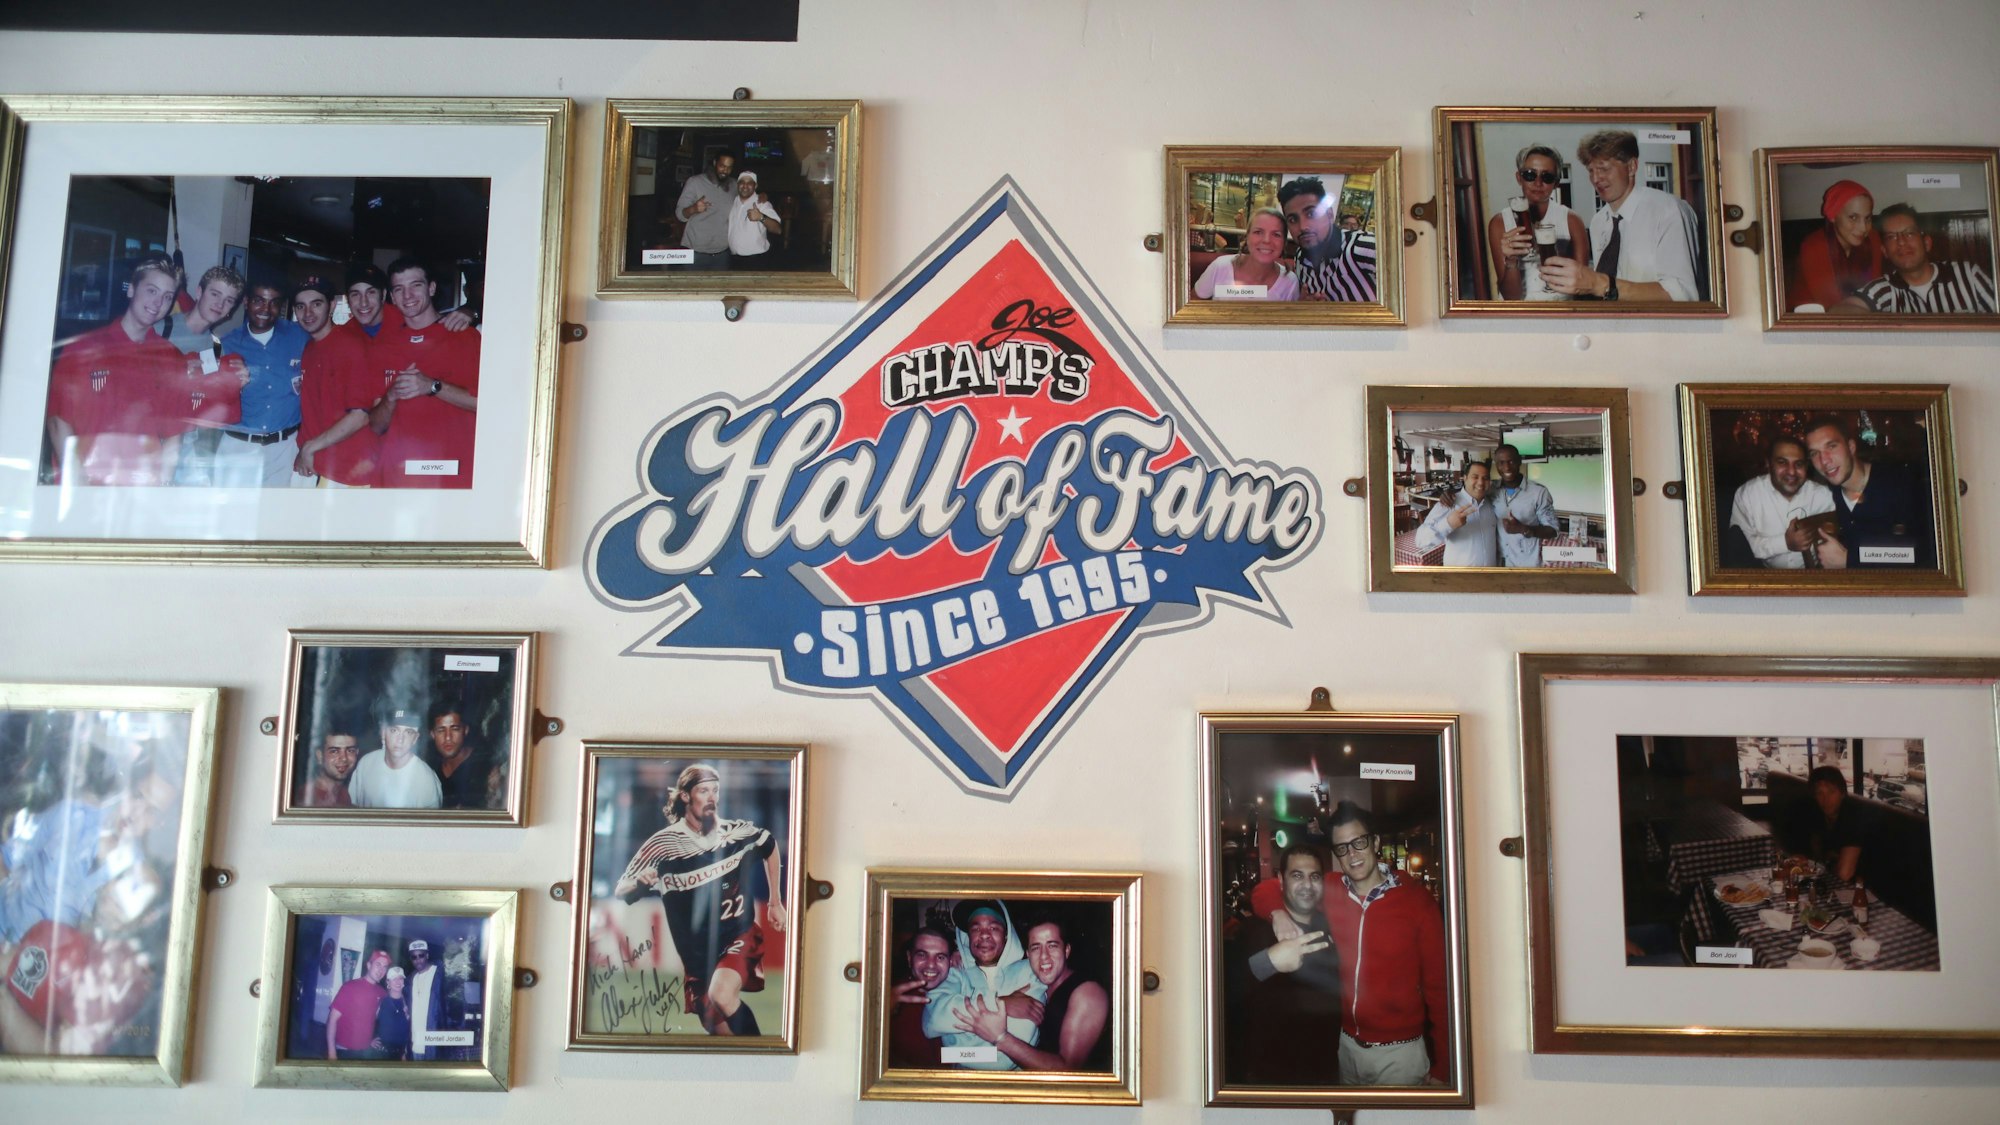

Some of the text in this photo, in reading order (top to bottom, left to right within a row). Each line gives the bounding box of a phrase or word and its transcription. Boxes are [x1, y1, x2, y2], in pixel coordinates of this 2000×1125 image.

[1647, 132, 1676, 141] Effenberg
[648, 253, 666, 261] Samy
[978, 299, 1077, 350] Joe
[882, 340, 1091, 409] CHAMPS
[636, 402, 1313, 574] Hall of Fame
[1883, 551, 1910, 559] Podolski
[820, 551, 1151, 678] Since 1995
[1361, 767, 1413, 776] Johnny Knoxville
[663, 856, 743, 890] REVOLUTION
[720, 894, 745, 921] 22
